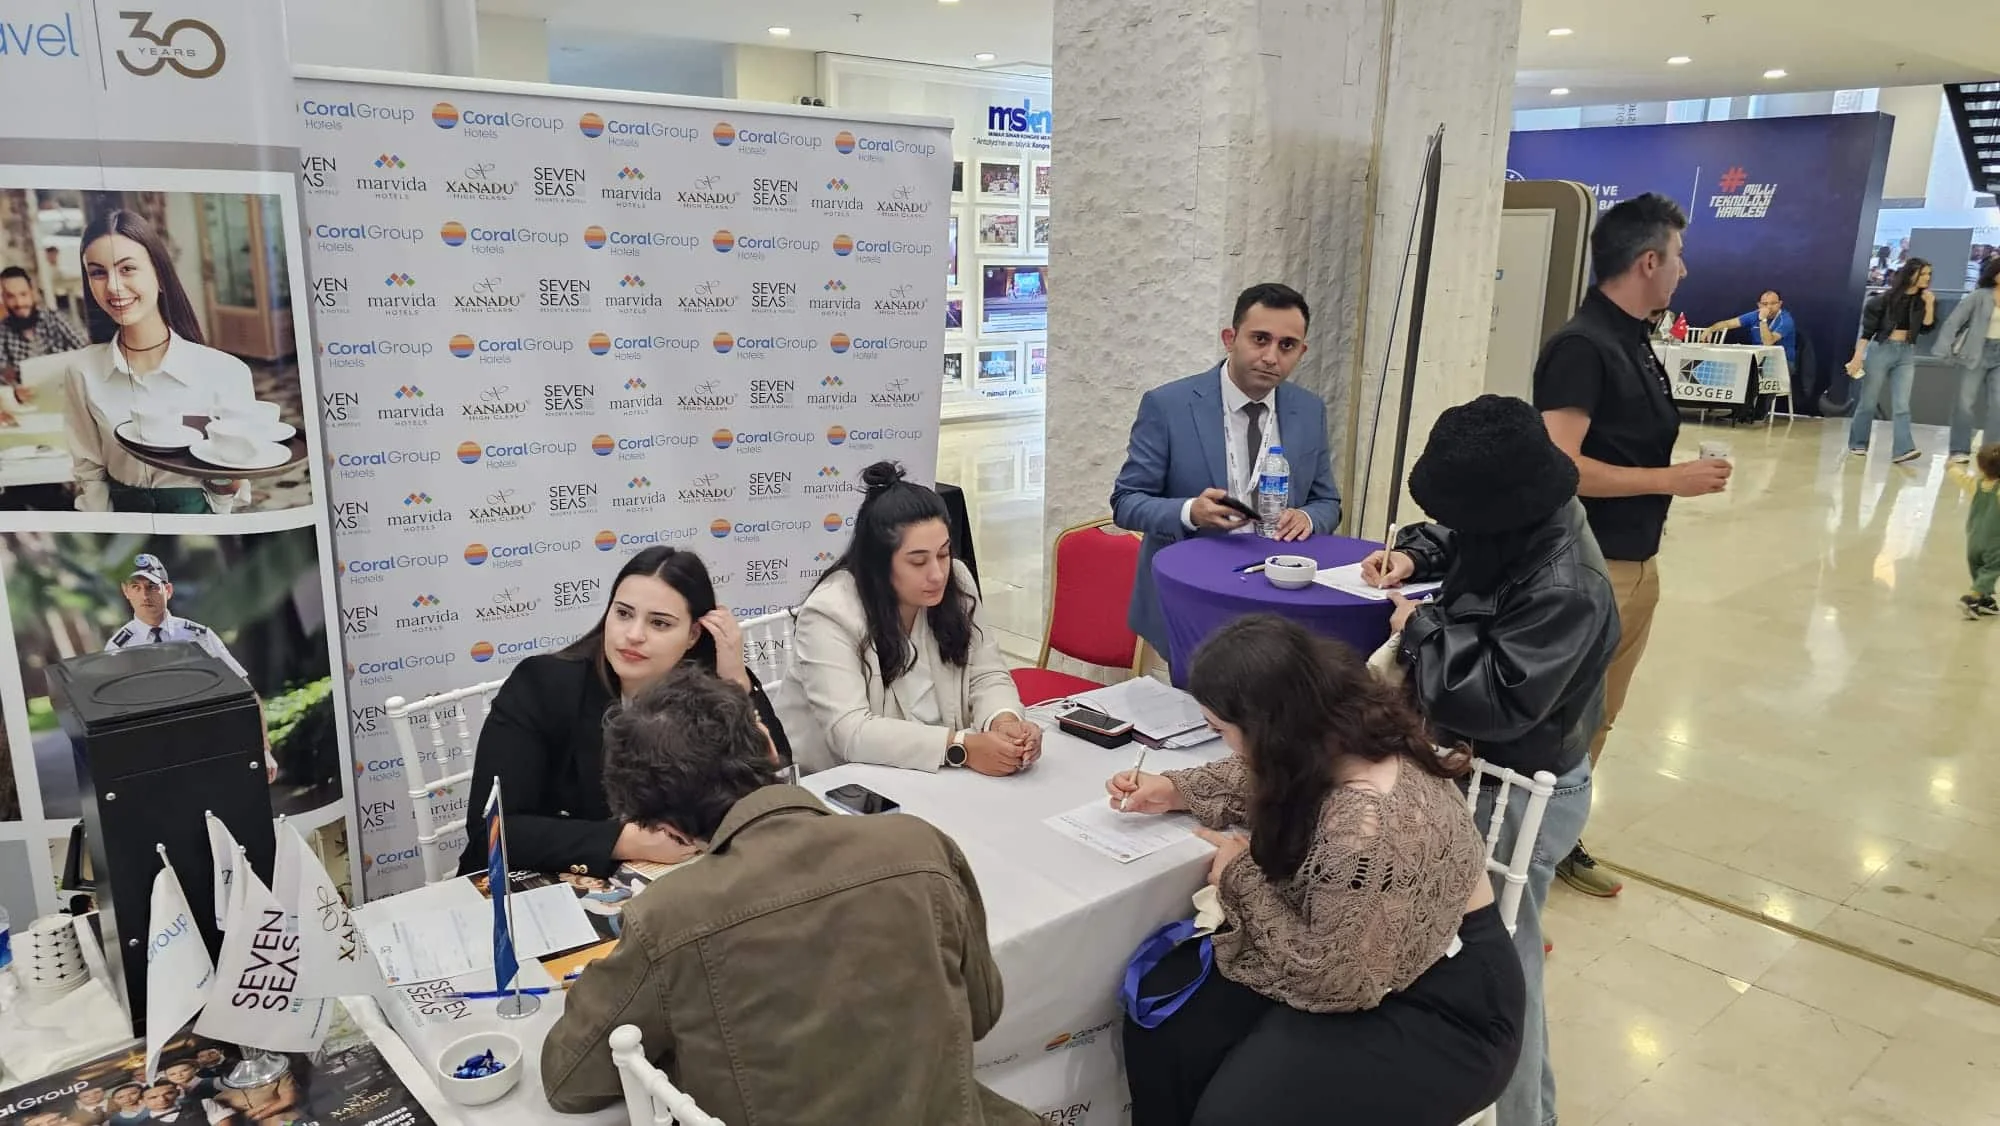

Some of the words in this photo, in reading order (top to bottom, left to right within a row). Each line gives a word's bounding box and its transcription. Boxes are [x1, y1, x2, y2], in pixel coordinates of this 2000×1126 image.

[117, 11, 226, 78] 30
[139, 48, 196, 57] YEARS
[303, 101, 415, 122] CoralGroup
[463, 111, 564, 131] CoralGroup
[608, 121, 699, 141] CoralGroup
[739, 129, 822, 150] CoralGroup
[858, 137, 935, 157] CoralGroup
[534, 167, 585, 182] SEVEN
[357, 177, 427, 192] marvida
[446, 180, 515, 195] XANADU
[534, 183, 575, 196] SEAS
[753, 178, 798, 192] SEVEN
[602, 187, 661, 201] marvida
[678, 192, 736, 204] XANADU
[753, 193, 787, 205] SEAS
[1709, 195, 1771, 207] TEKNOLOJİ
[811, 197, 863, 211] marvida
[877, 201, 928, 213] XANADU
[316, 224, 424, 243] CoralGroup
[470, 228, 569, 245] CoralGroup
[610, 232, 699, 249] CoralGroup
[738, 236, 820, 251] CoralGroup
[856, 240, 931, 255] CoralGroup
[539, 280, 590, 292] SEVEN
[752, 282, 795, 295] SEVEN
[368, 293, 436, 307] marvida
[454, 295, 520, 307] XANADU
[540, 294, 579, 306] SEAS
[605, 293, 662, 307] marvida
[678, 297, 735, 307] XANADU
[752, 296, 786, 307] SEAS
[809, 297, 860, 310] marvida
[874, 300, 924, 310] XANADU
[328, 340, 432, 356] CoralGroup
[479, 338, 573, 352] CoralGroup
[614, 336, 699, 351] CoralGroup
[737, 337, 817, 351] CoralGroup
[853, 338, 927, 351] CoralGroup
[544, 384, 594, 397] SEVEN
[751, 380, 794, 392] SEVEN
[1674, 385, 1733, 400] KOSGEB
[545, 398, 584, 410] SEAS
[609, 394, 662, 410] marvida
[678, 395, 734, 406] XANADU
[751, 392, 784, 404] SEAS
[807, 392, 857, 404] marvida
[870, 393, 920, 403] XANADU
[378, 403, 444, 420] marvida
[462, 402, 526, 416] XANADU
[618, 434, 698, 449] CoralGroup
[736, 431, 815, 444] CoralGroup
[850, 429, 922, 440] CoralGroup
[486, 441, 576, 457] CoralGroup
[339, 450, 441, 467] CoralGroup
[750, 471, 791, 484] SEVEN
[550, 483, 597, 497] SEVEN
[678, 487, 733, 500] XANADU
[750, 484, 781, 496] SEAS
[804, 481, 853, 494] marvida
[550, 497, 586, 511] SEAS
[612, 491, 666, 506] marvida
[387, 510, 452, 526] marvida
[469, 504, 532, 519] XANADU
[734, 520, 811, 533] CoralGroup
[620, 526, 698, 545] CoralGroup
[492, 540, 581, 557] CoralGroup
[349, 553, 448, 573] CoralGroup
[746, 558, 788, 571] SEVEN
[746, 571, 778, 581] SEAS
[554, 578, 599, 594] SEVEN
[555, 593, 590, 606] SEAS
[475, 601, 537, 618] XANADU
[732, 605, 799, 616] CoralGr
[396, 609, 458, 628] marvida
[498, 636, 578, 654] CoralGrou
[359, 652, 455, 675] CoralGroup
[408, 706, 464, 724] mavid
[377, 837, 467, 865] Coraloup
[232, 910, 284, 1009] SEVEN
[407, 987, 442, 1016] SEAS
